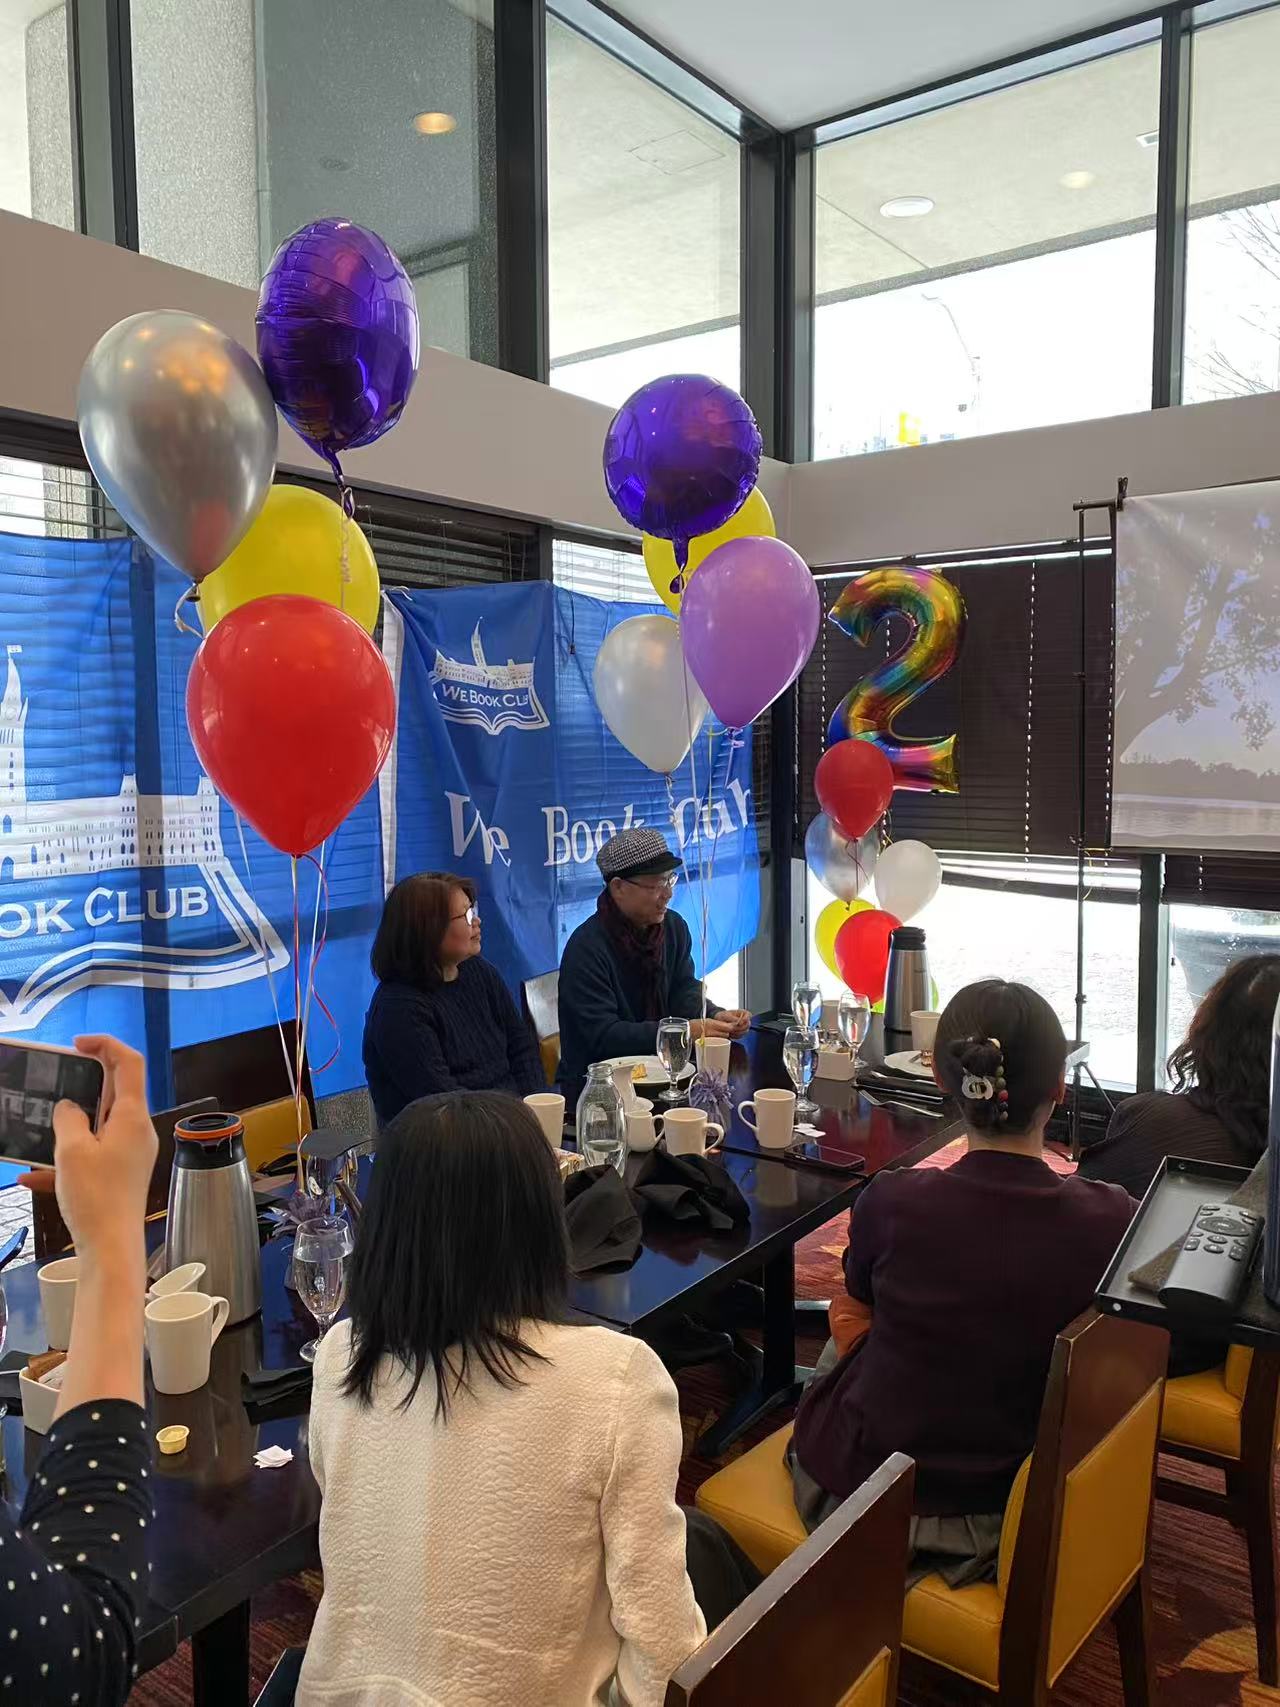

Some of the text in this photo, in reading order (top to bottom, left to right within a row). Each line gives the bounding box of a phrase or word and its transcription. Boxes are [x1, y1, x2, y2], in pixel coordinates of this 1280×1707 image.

[442, 683, 468, 702] WE
[470, 689, 502, 707] BOOK
[828, 566, 965, 793] 2
[84, 887, 209, 927] CLUB
